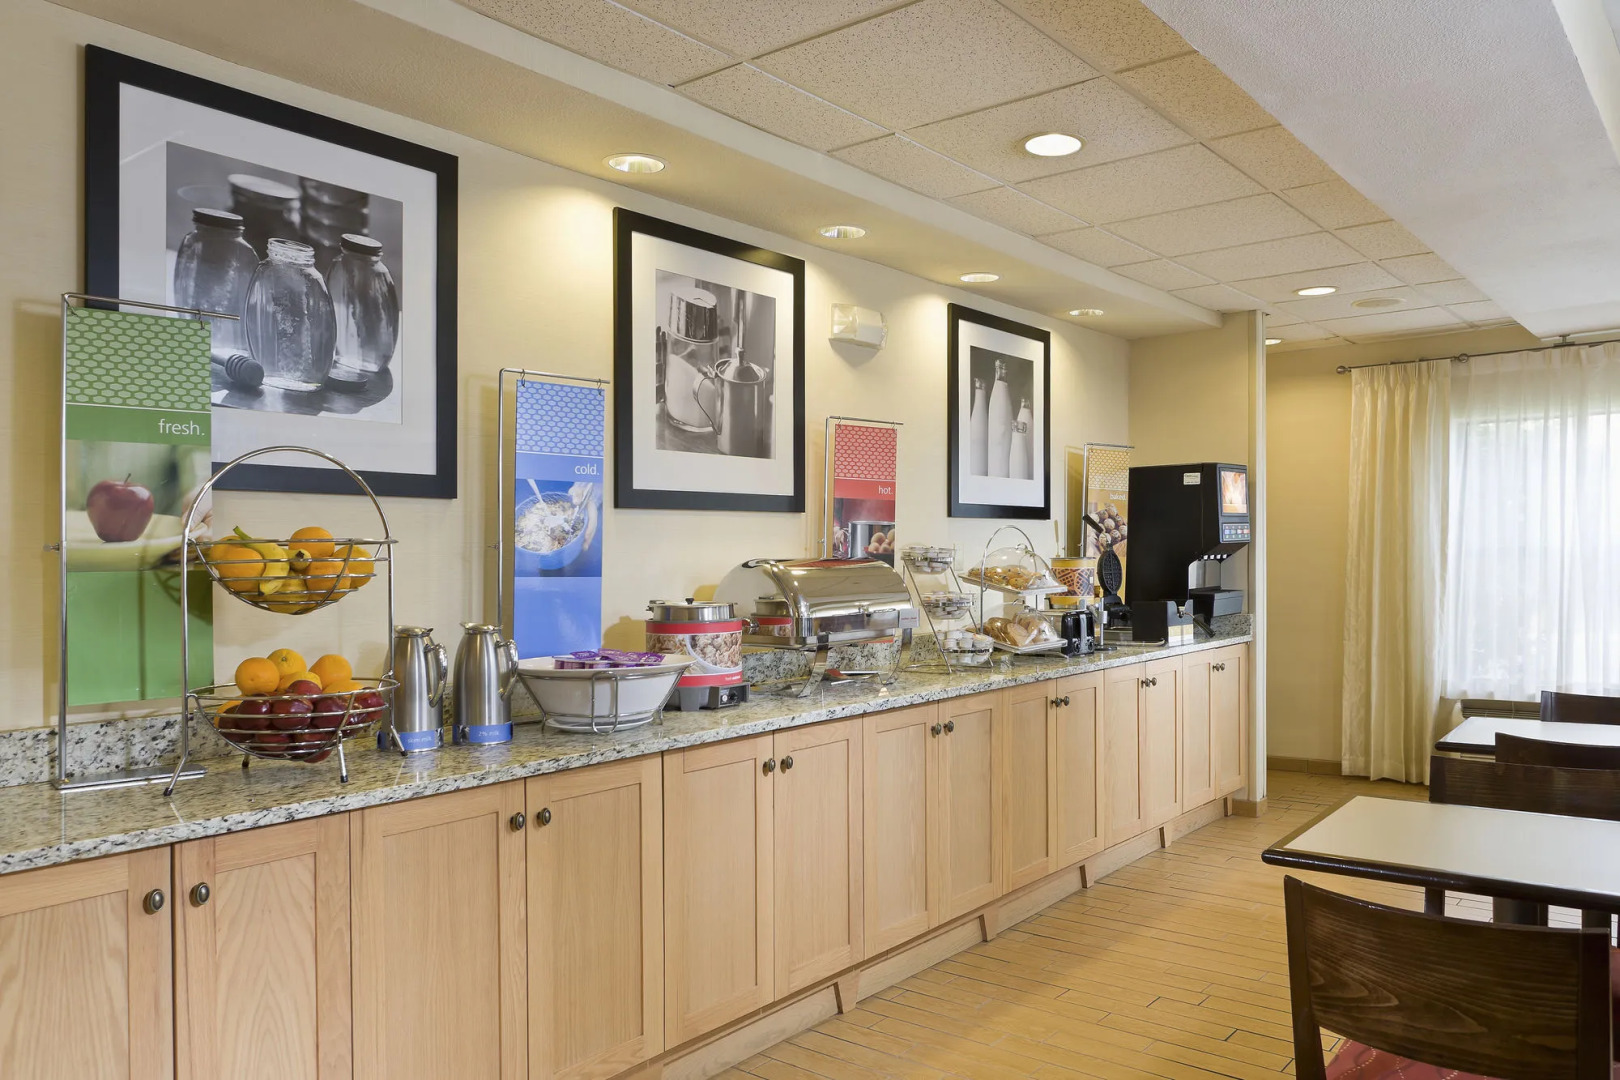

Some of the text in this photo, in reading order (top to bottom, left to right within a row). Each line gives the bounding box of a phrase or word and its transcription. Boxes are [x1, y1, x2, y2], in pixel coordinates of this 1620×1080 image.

[158, 418, 205, 436] fresh.
[574, 463, 600, 476] cold.
[878, 485, 893, 495] hot.
